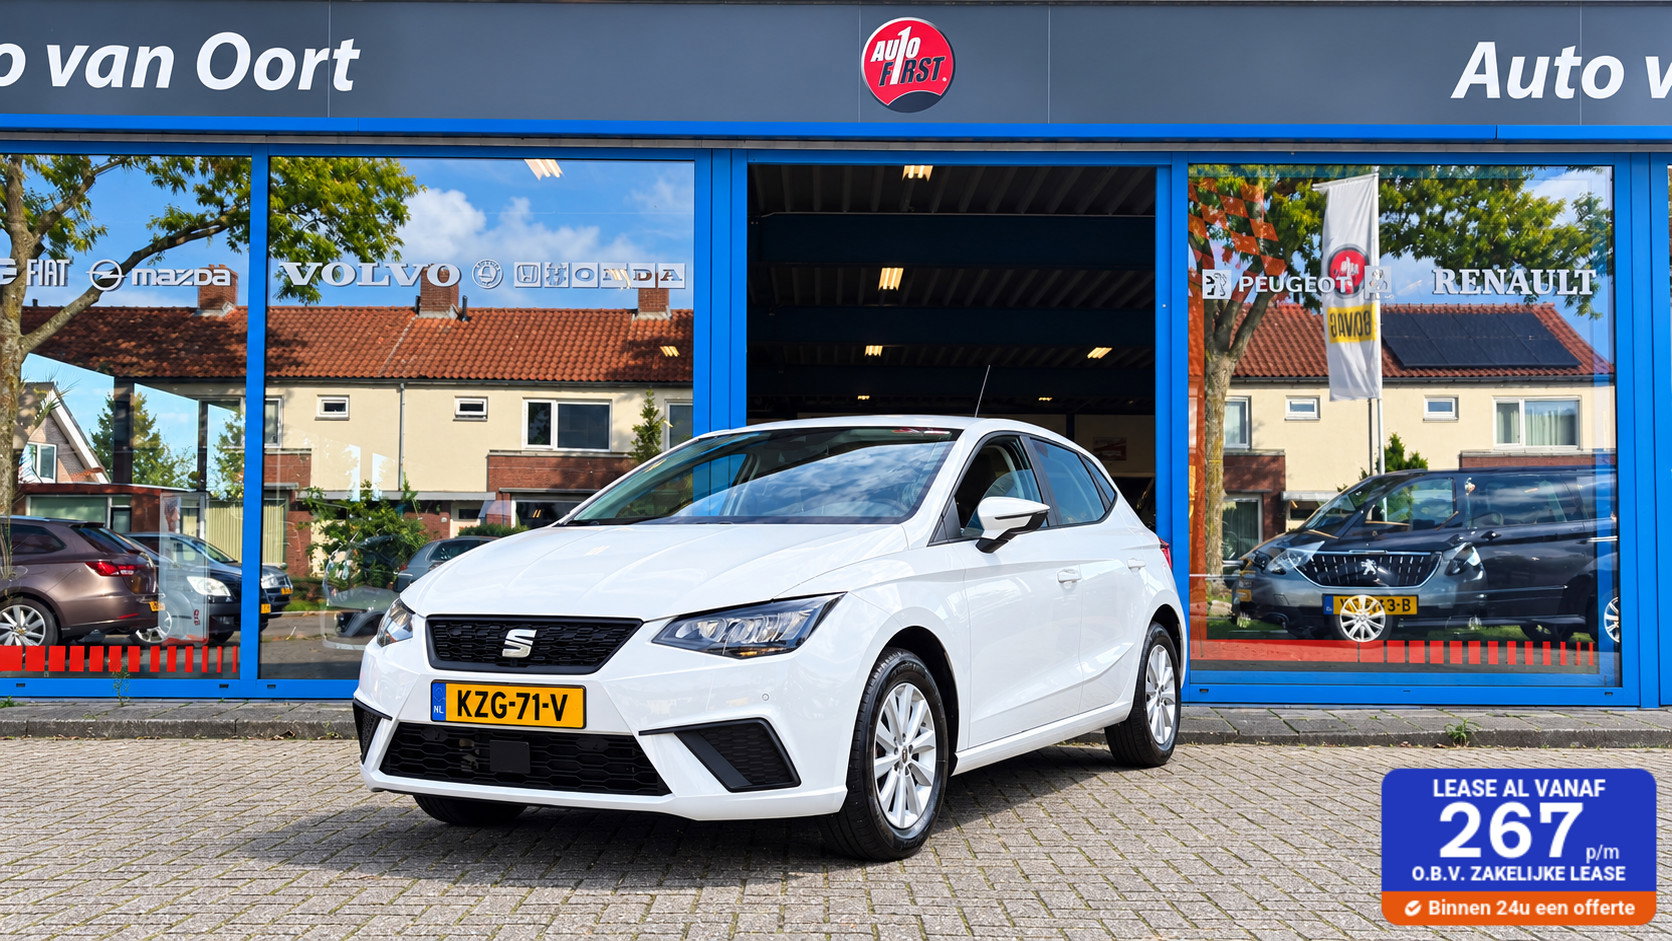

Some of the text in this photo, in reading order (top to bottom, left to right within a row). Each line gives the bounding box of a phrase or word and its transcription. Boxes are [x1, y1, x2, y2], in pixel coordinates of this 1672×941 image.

[47, 44, 175, 89] van
[196, 31, 361, 91] Oort
[1450, 41, 1625, 99] Auto
[26, 259, 70, 286] FIAT
[278, 262, 462, 287] VOLVO
[1238, 276, 1348, 293] PEUGEOT
[1432, 269, 1597, 295] RENAULT
[433, 705, 444, 714] NL
[457, 689, 568, 722] KZG-71-V
